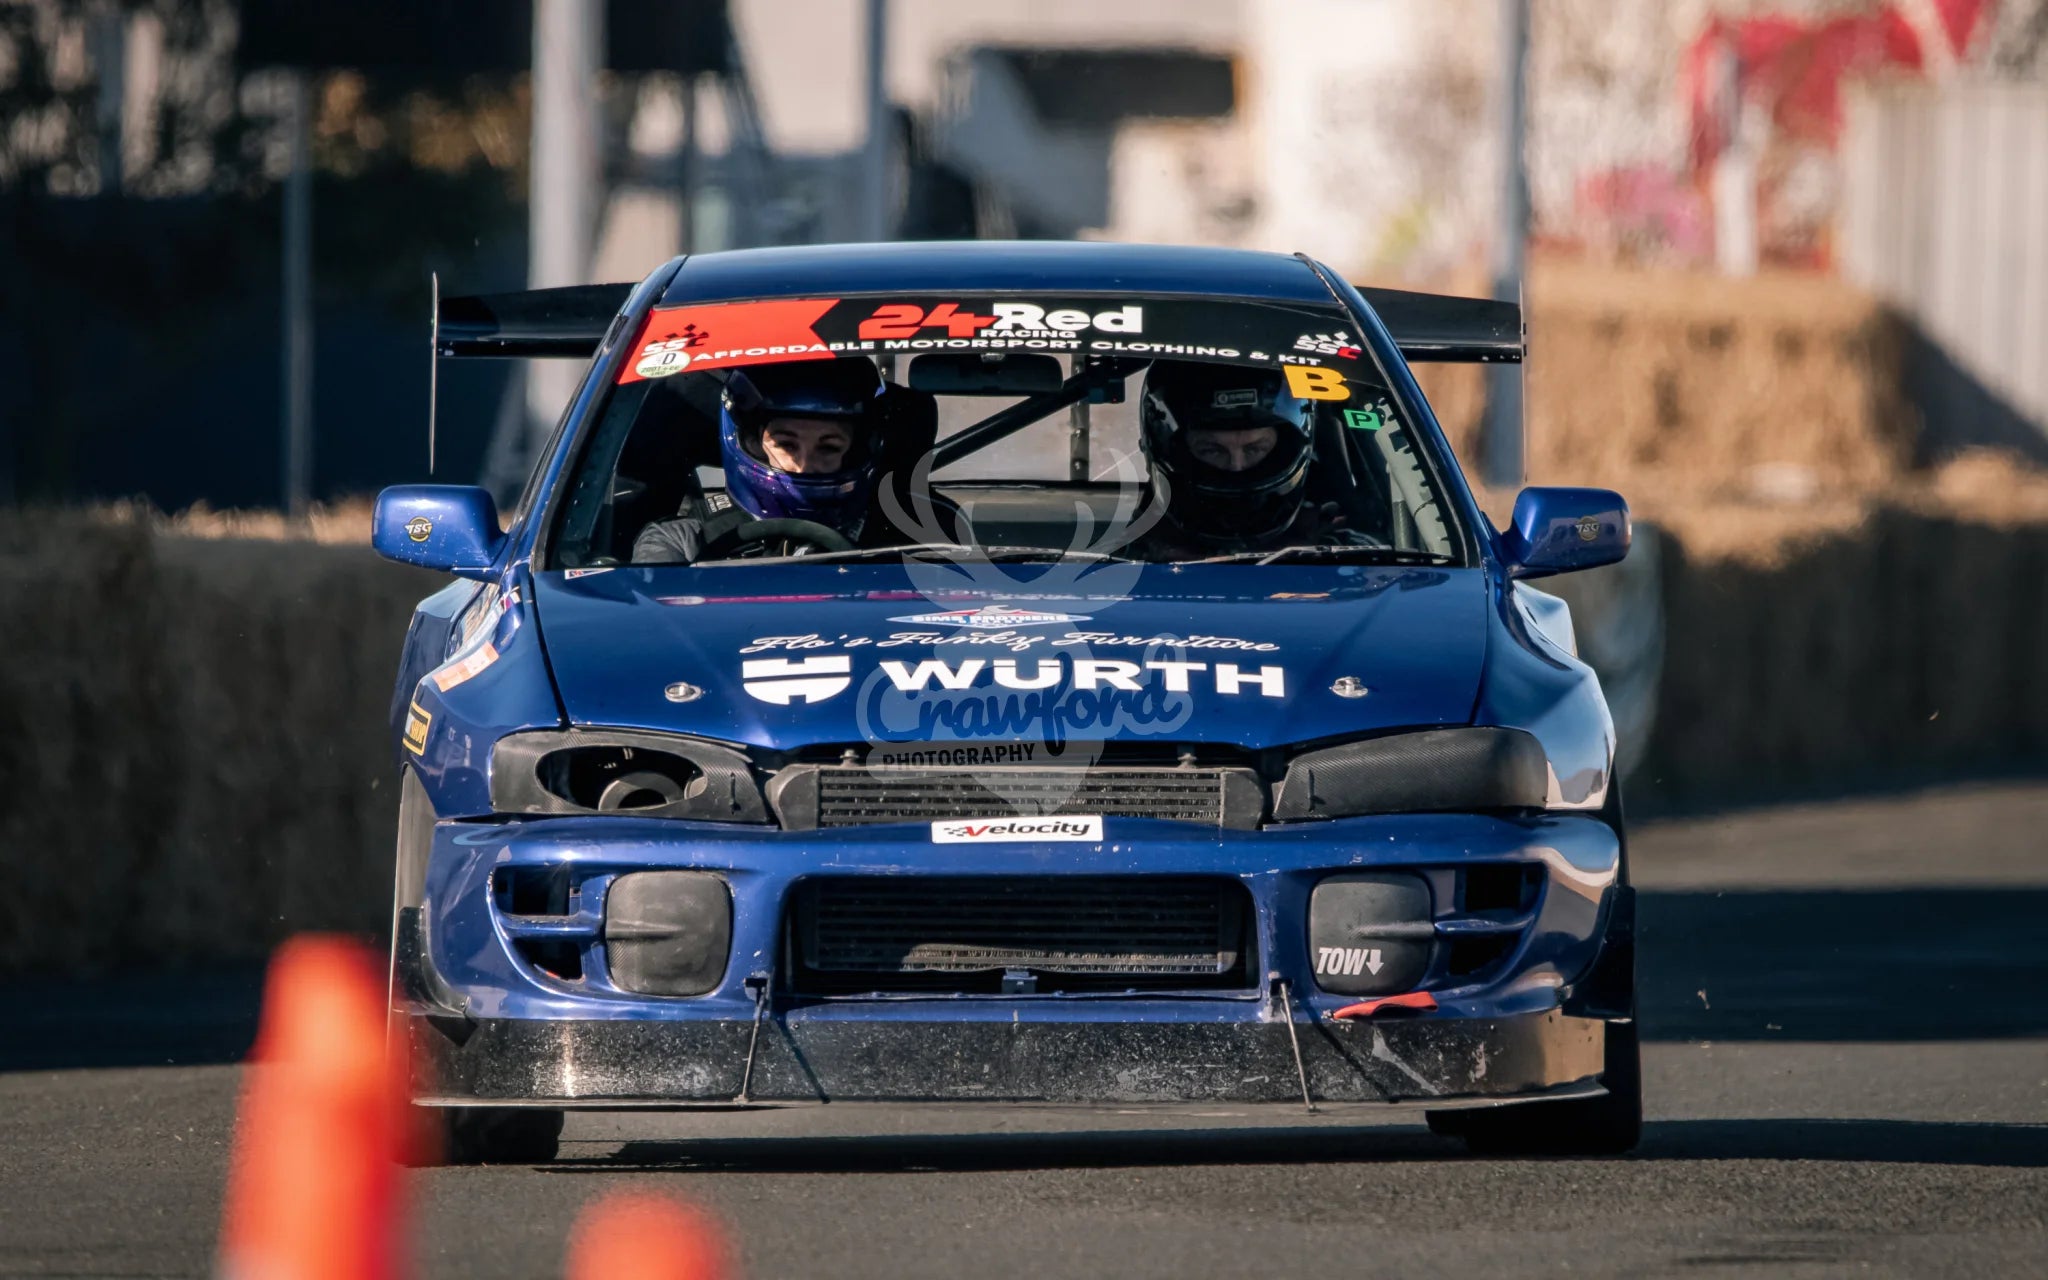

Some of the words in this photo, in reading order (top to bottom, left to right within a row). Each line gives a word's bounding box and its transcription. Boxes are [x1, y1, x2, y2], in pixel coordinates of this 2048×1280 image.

[980, 329, 1077, 338] RACING
[692, 341, 875, 361] AFFORDABLE
[884, 339, 1083, 350] MOTORSPORT
[1090, 341, 1241, 358] CLOTHING
[1249, 352, 1270, 361] &
[1278, 354, 1322, 366] KIT
[1293, 337, 1362, 361] SSC
[1283, 365, 1351, 401] B
[1351, 412, 1376, 428] P
[740, 633, 873, 653] Flo's
[876, 631, 1045, 651] Funky
[1052, 631, 1280, 651] Furniture
[879, 659, 1285, 698] WÜRTH
[964, 821, 1090, 837] Velocity
[1316, 947, 1369, 976] TOW
